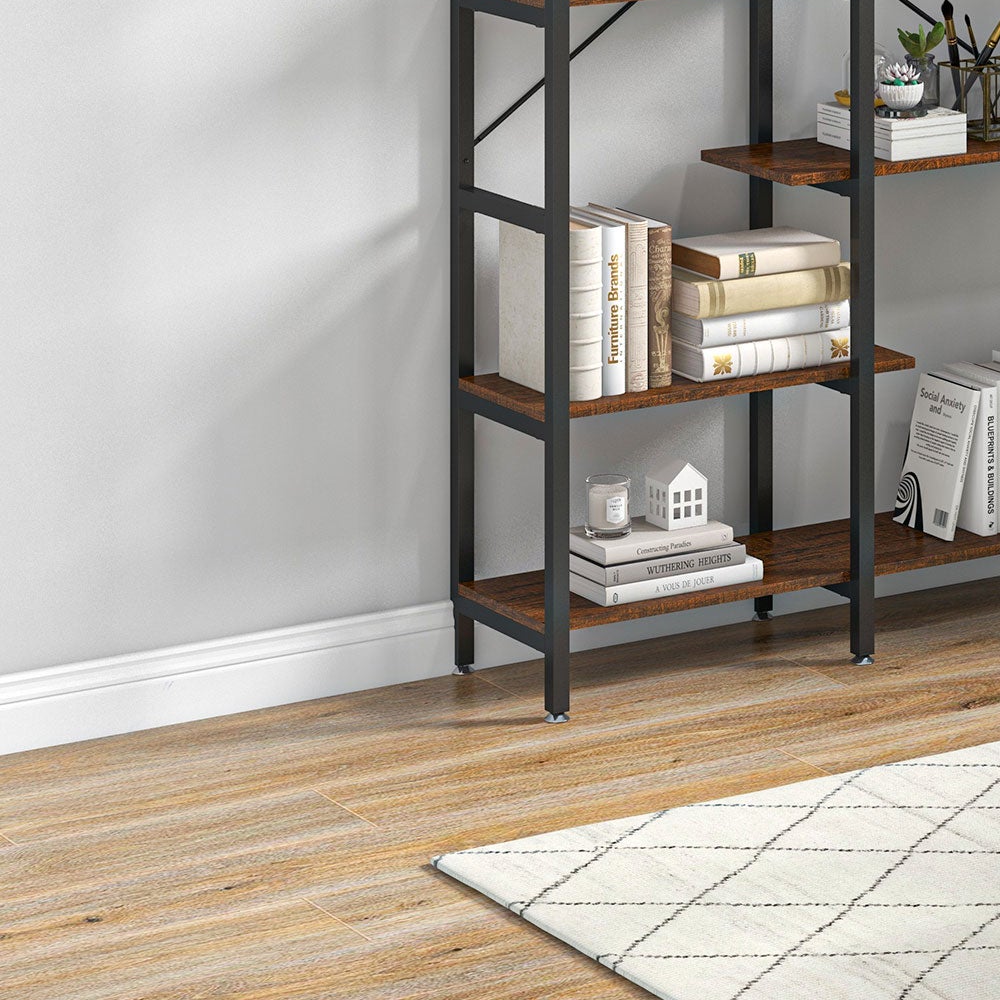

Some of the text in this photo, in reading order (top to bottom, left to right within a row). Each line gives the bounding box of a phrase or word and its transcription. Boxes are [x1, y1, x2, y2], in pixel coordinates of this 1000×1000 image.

[607, 253, 618, 365] Furniture Brands
[920, 387, 940, 403] Social
[940, 394, 966, 414] Anxiety
[929, 404, 943, 415] and
[987, 473, 995, 515] BUILDINGS
[636, 544, 670, 556] Constructing
[646, 553, 732, 576] WUTHERING HEIGHTS
[662, 581, 680, 591] VOUS
[682, 580, 692, 588] DE
[693, 575, 715, 587] JOUER
